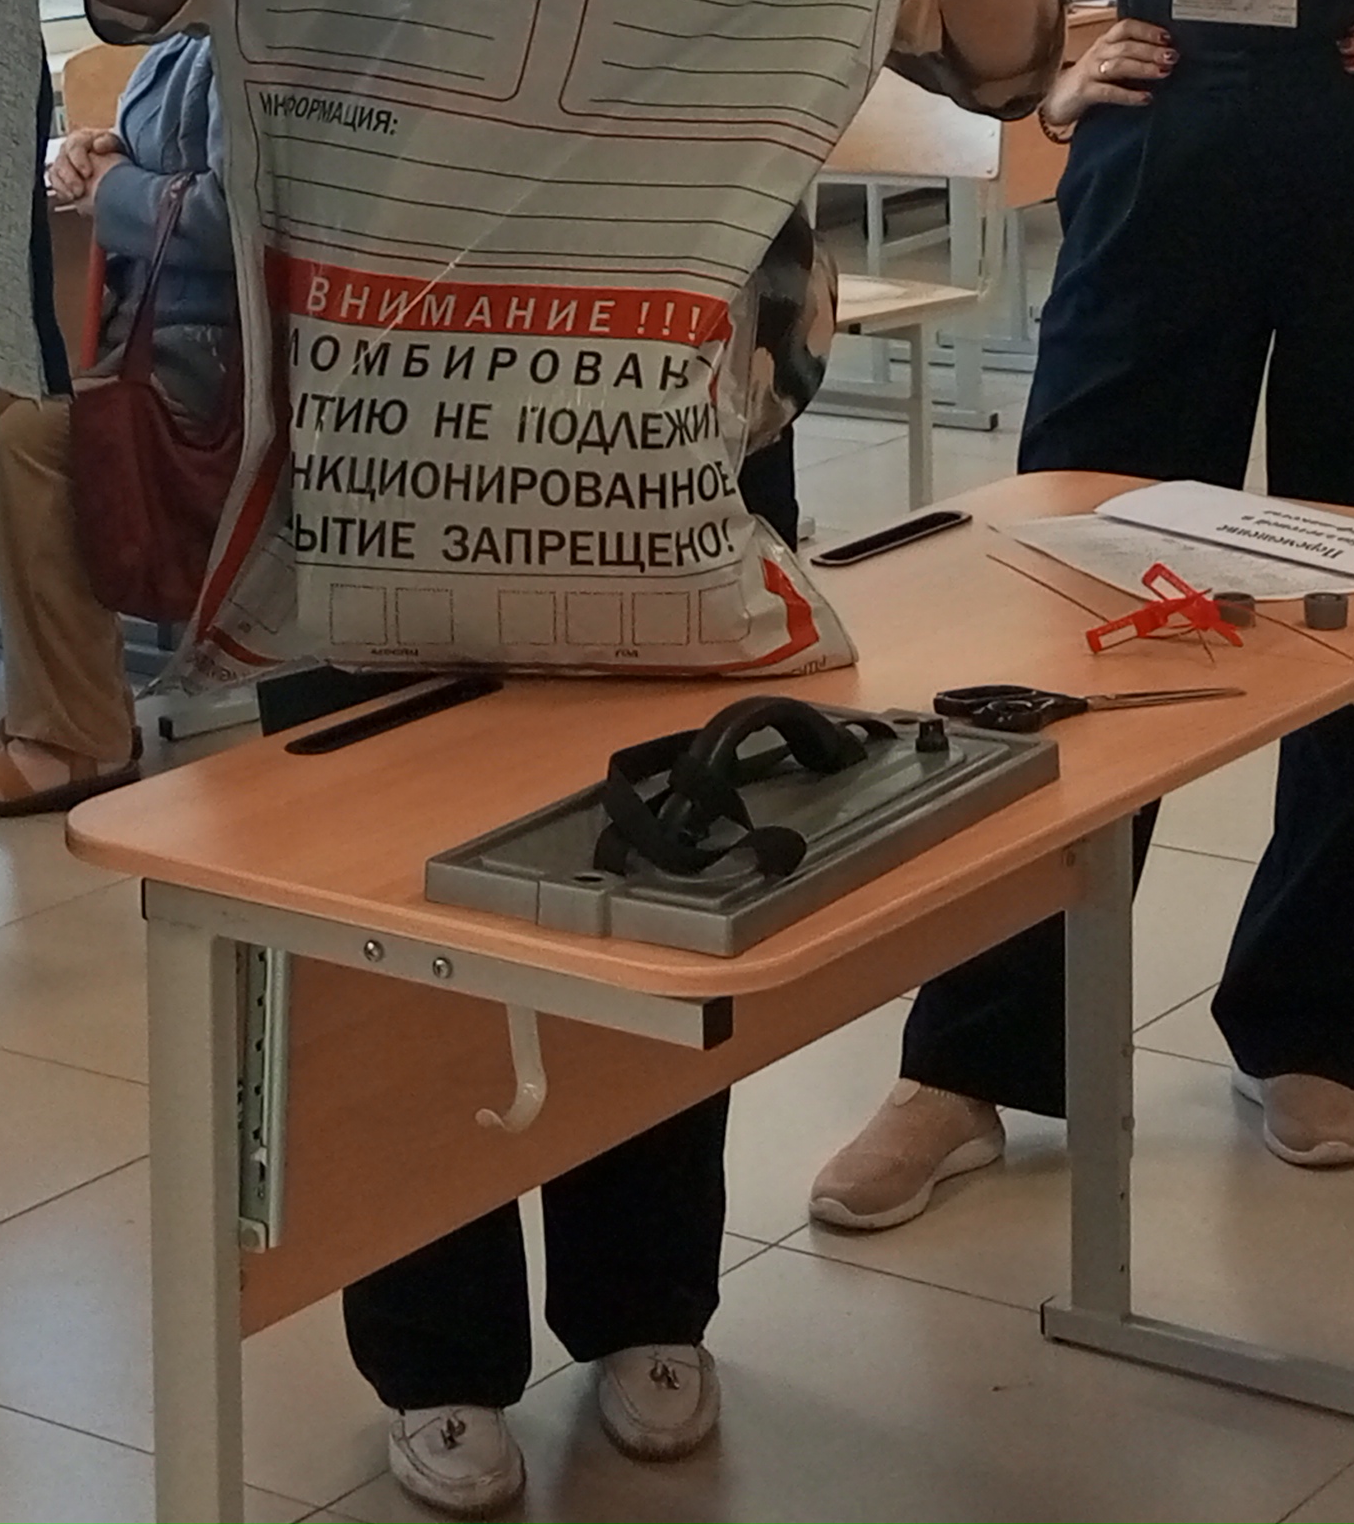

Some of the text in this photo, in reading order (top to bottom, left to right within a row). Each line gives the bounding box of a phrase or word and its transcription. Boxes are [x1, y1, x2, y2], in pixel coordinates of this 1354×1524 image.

[258, 91, 399, 136] ИНФОРМАЦИЯ:
[306, 274, 616, 334] ВНИМАНИЕ
[433, 401, 493, 441] НЕ
[440, 517, 734, 573] ЗАПРЕЩЕНО!
